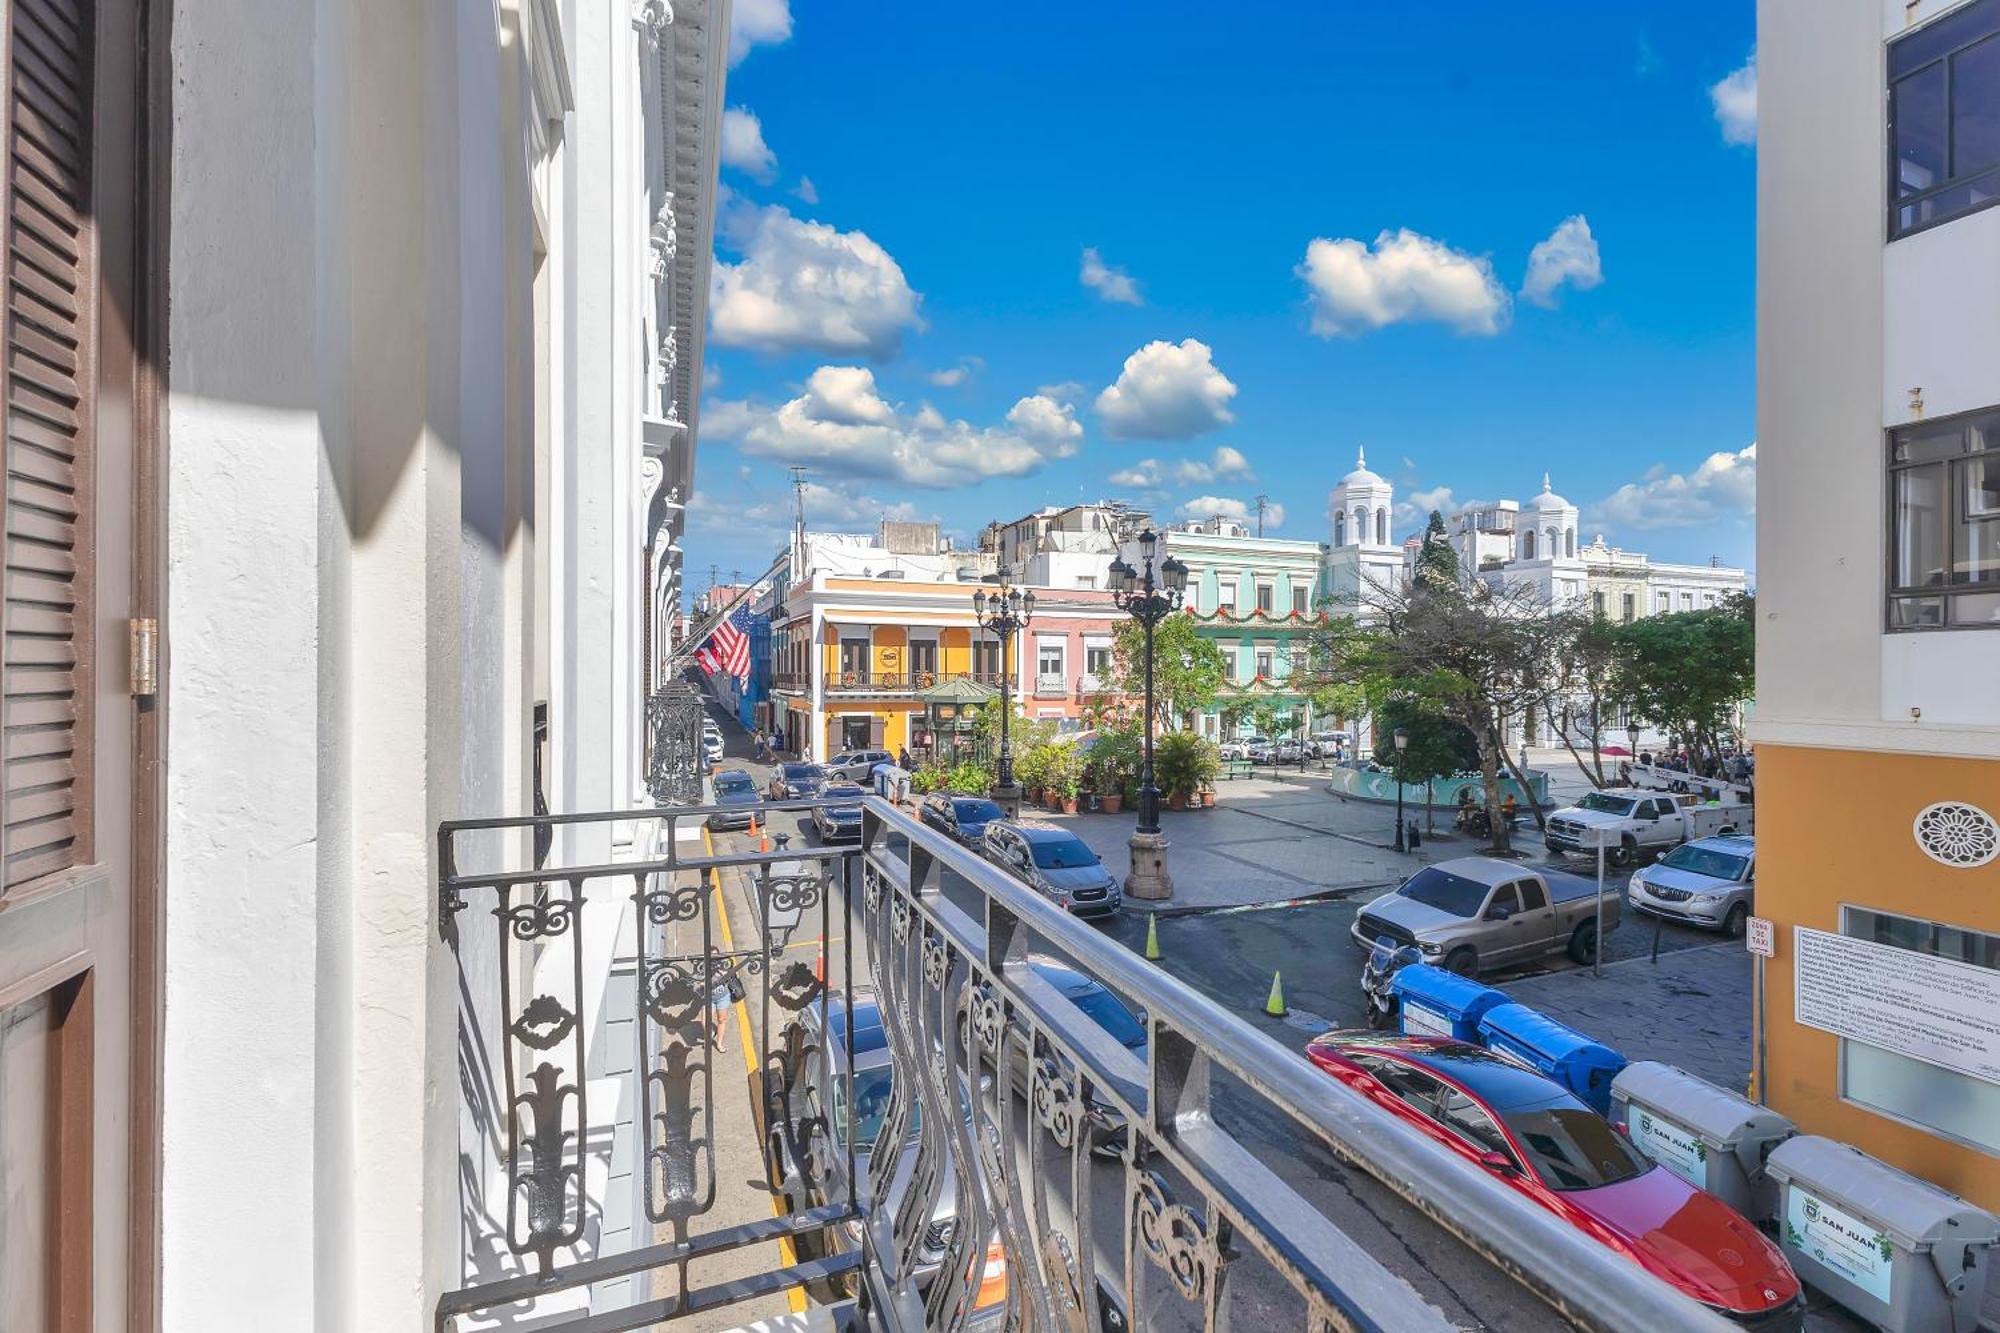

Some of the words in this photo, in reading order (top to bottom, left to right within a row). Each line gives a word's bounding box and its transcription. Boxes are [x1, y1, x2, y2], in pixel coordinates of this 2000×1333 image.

[1752, 936, 1768, 947] TAXI
[1654, 1128, 1670, 1141] SAN
[1672, 1139, 1694, 1154] JUAN
[1822, 1215, 1844, 1233] SAN
[1846, 1230, 1876, 1251] JUAN
